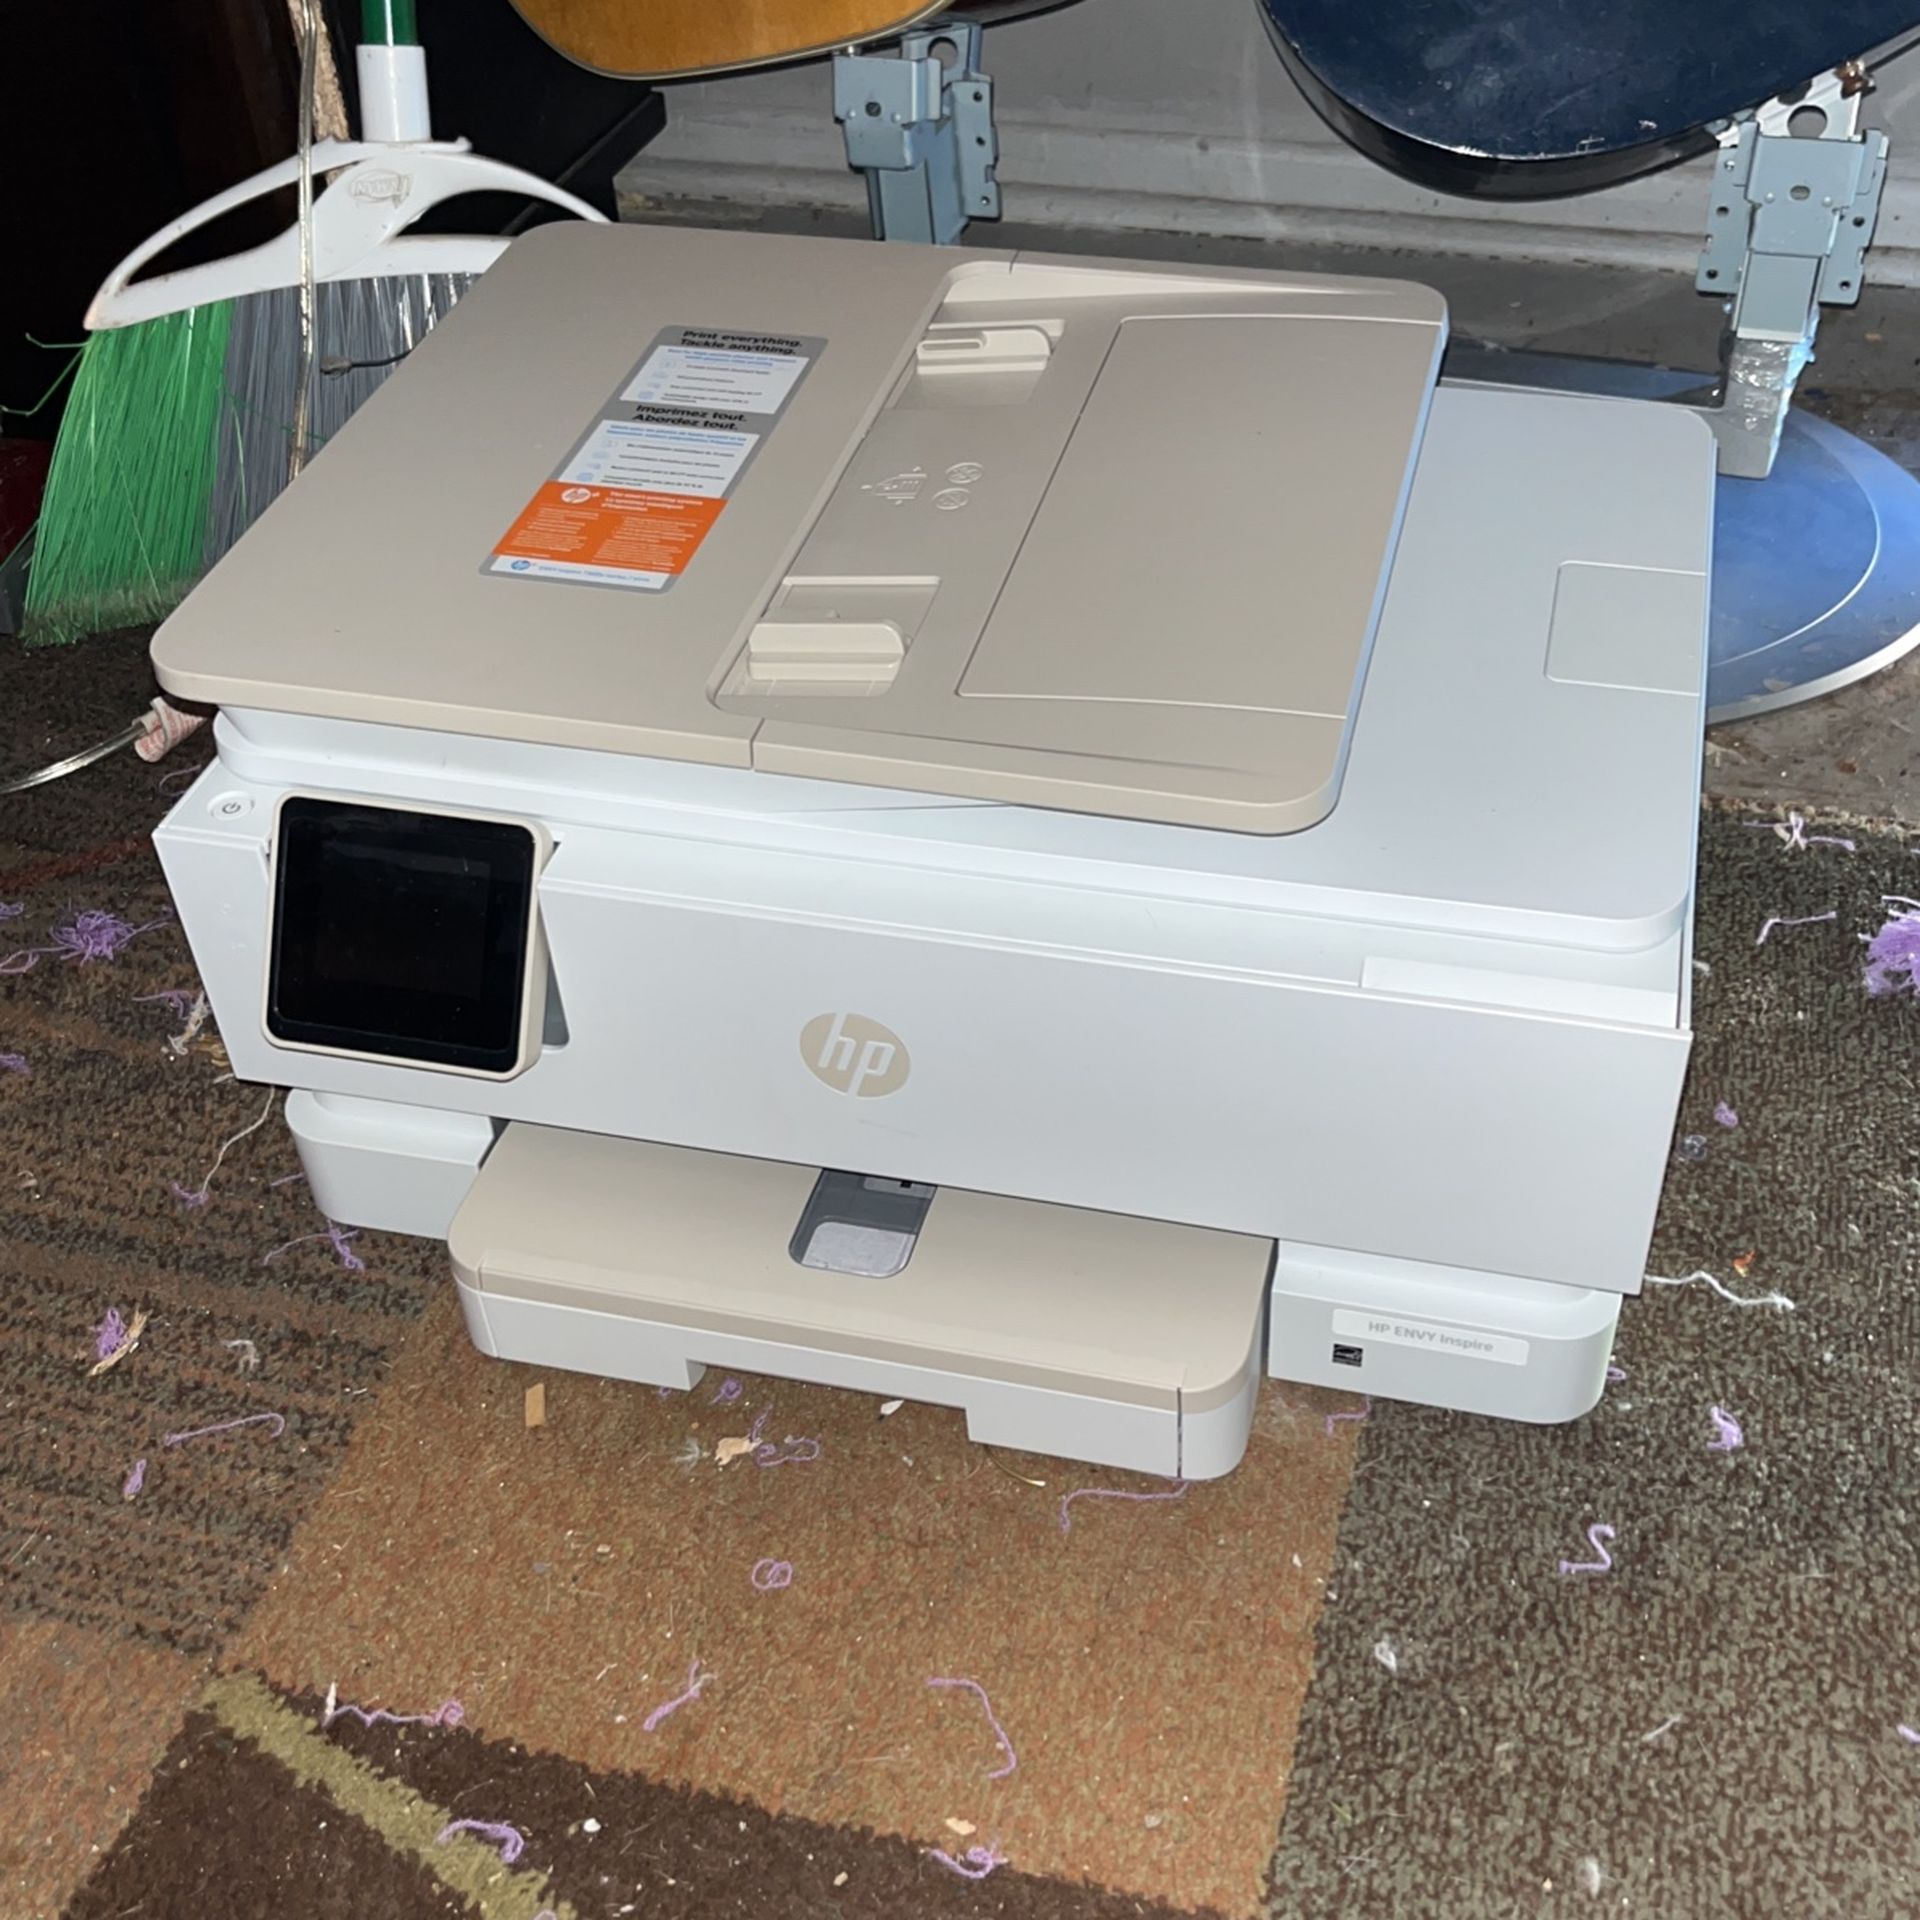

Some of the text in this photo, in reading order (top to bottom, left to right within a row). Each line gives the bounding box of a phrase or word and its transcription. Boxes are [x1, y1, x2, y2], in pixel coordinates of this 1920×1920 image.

[680, 338, 725, 349] Tackle
[728, 343, 796, 356] anything.
[682, 330, 803, 348] Print everything.
[632, 413, 738, 431] Abordez tout.
[636, 404, 747, 422] Imprimez tout.
[816, 1011, 897, 1099] hp
[1368, 1321, 1494, 1352] HP ENVY Inspire
